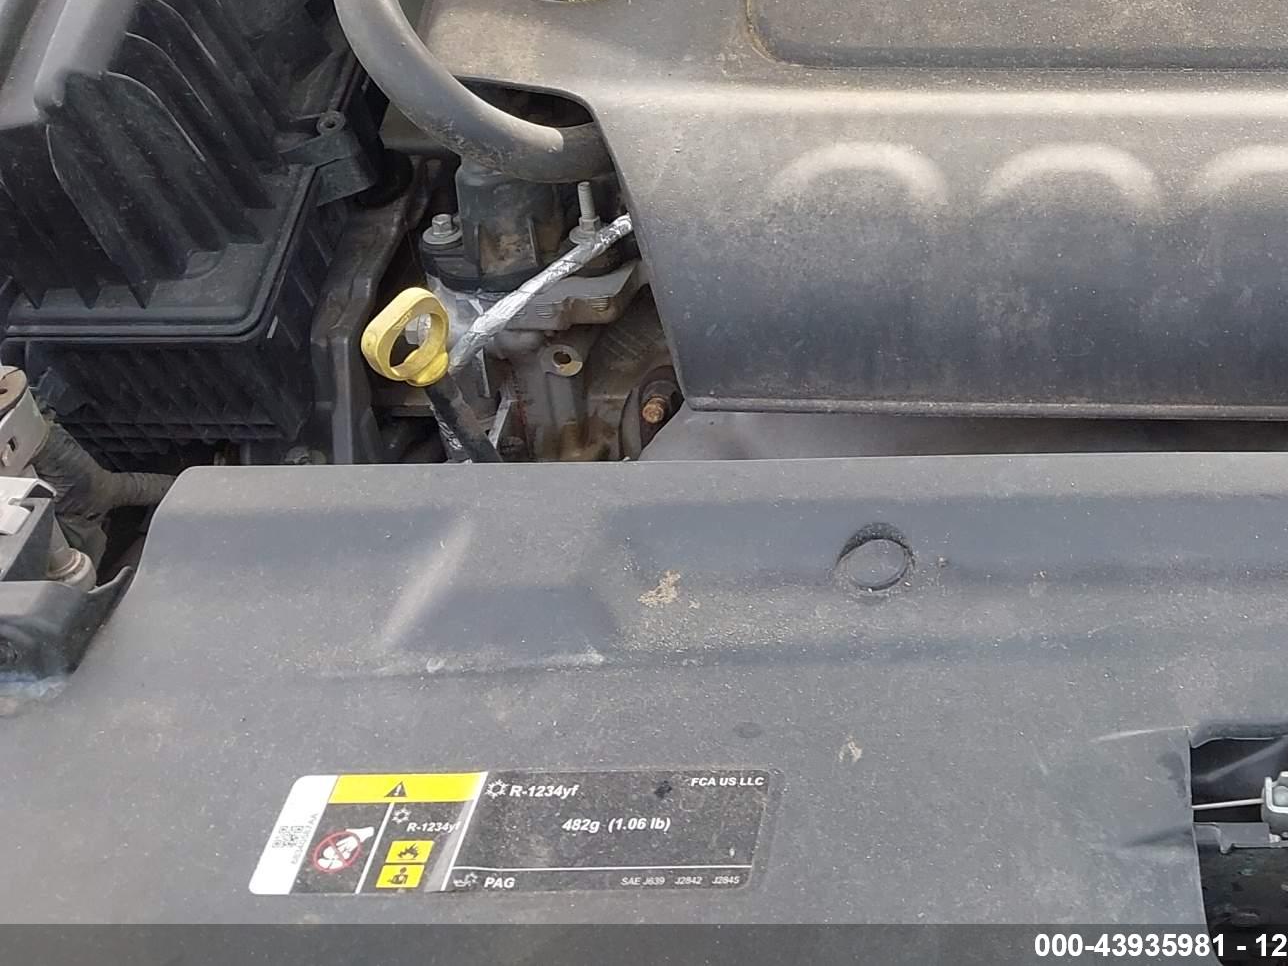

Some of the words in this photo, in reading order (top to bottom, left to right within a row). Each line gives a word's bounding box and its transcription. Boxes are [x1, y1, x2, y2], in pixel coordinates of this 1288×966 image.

[690, 777, 717, 787] FCA
[719, 777, 738, 787] US
[739, 776, 764, 786] LLC
[509, 784, 579, 799] R-1234yf
[406, 821, 460, 833] R-1234yf
[562, 818, 600, 833] 482g
[607, 817, 646, 833] (1.06
[650, 817, 671, 832] lb)
[484, 877, 516, 888] PAG
[621, 876, 641, 885] SAE
[642, 876, 666, 885] J639
[674, 875, 703, 885] J2842
